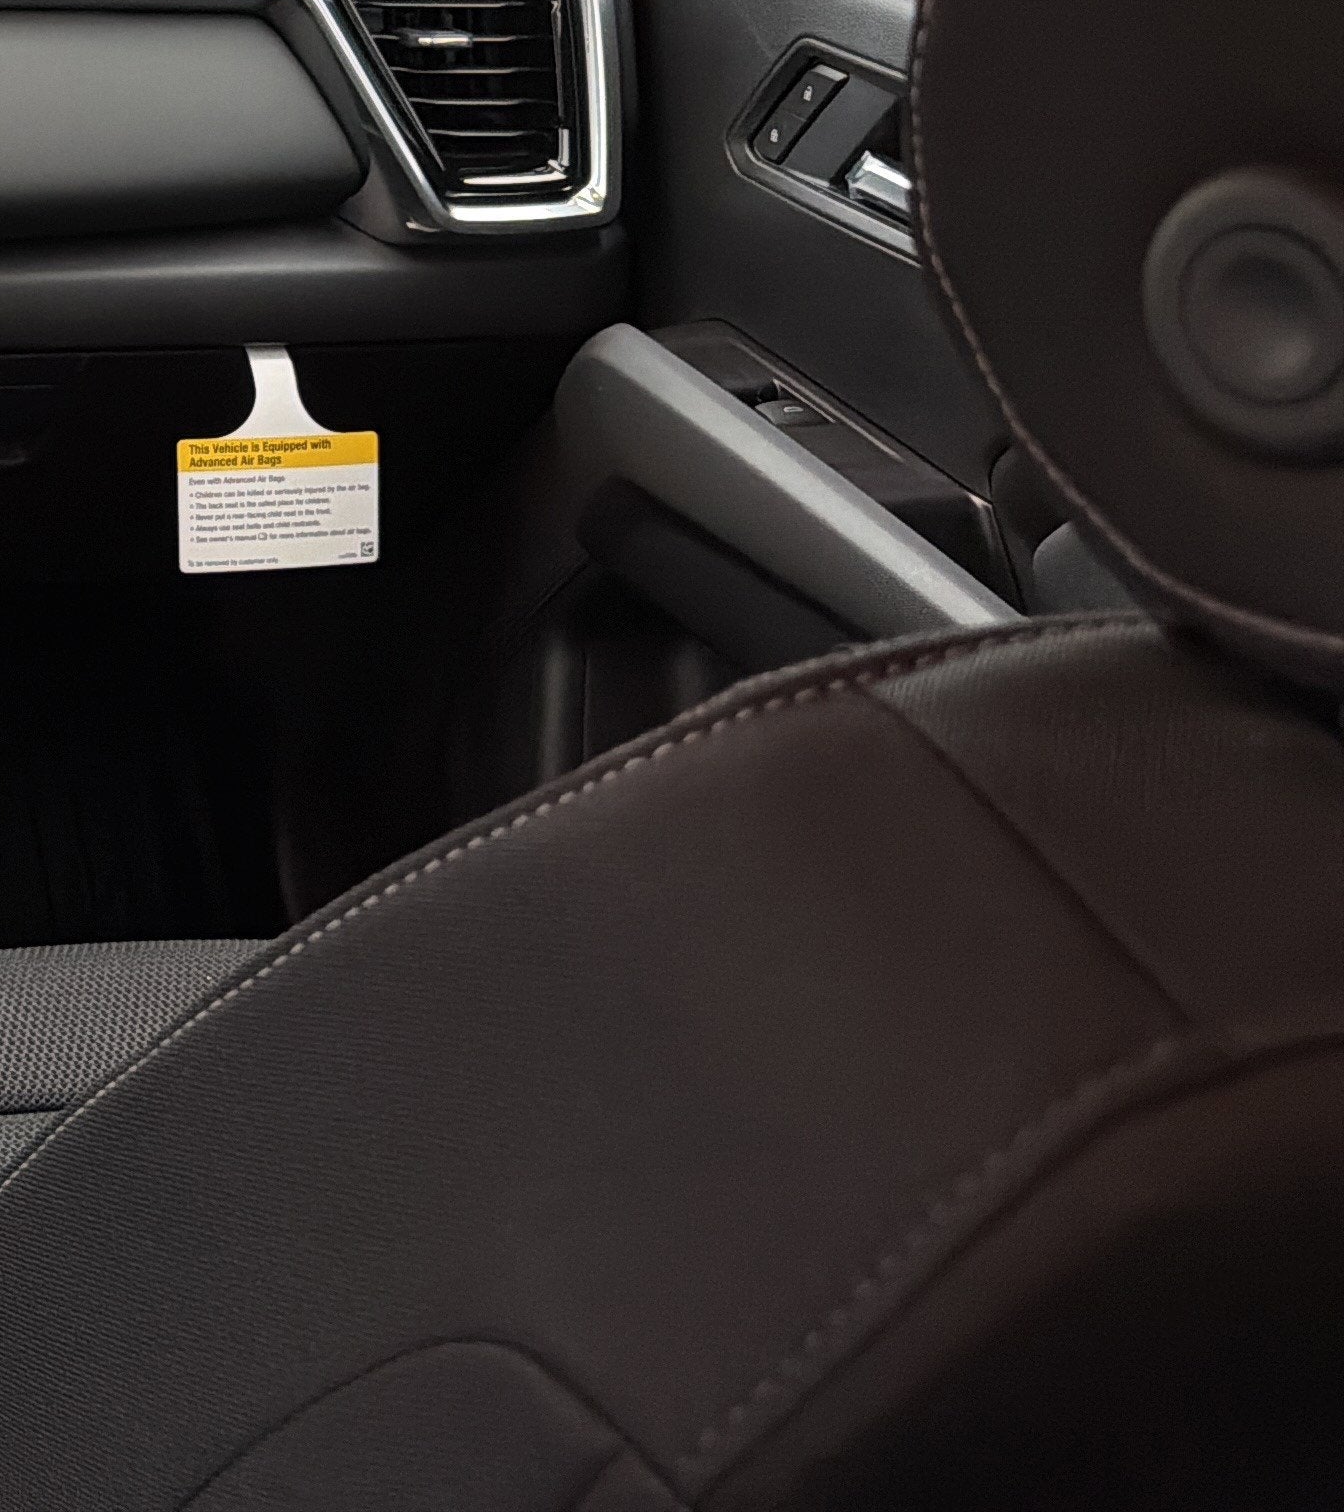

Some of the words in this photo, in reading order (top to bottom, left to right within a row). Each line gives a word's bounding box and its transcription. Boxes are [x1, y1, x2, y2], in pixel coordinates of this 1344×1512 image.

[189, 444, 210, 455] This
[213, 442, 248, 454] Vehicle
[263, 439, 307, 453] Equipped
[310, 439, 331, 450] with
[189, 457, 238, 468] Advanced
[240, 455, 254, 465] Air
[257, 454, 282, 466] Bags
[207, 477, 221, 485] with
[223, 476, 256, 484] Advanced
